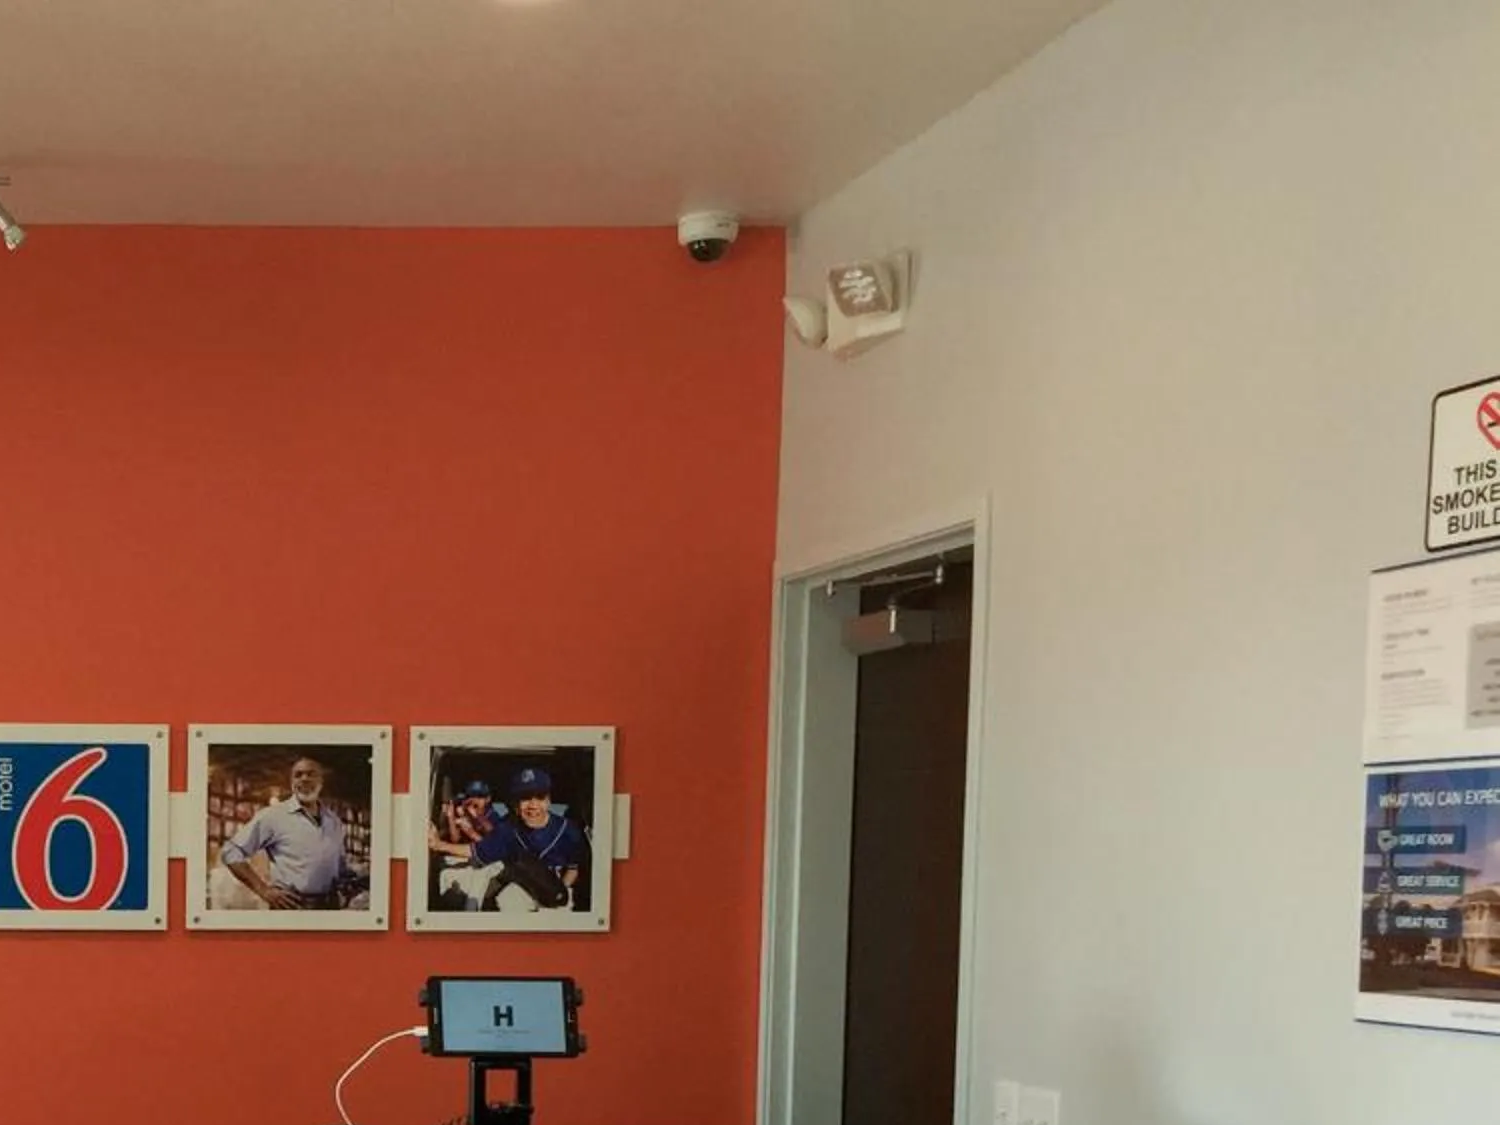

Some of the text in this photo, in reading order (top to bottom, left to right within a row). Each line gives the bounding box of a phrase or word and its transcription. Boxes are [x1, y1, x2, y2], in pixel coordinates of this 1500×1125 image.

[1454, 459, 1497, 485] THIS
[1432, 482, 1500, 515] SMOKE
[1379, 792, 1410, 808] WHAT
[1412, 791, 1436, 807] YOU
[1437, 789, 1462, 806] CAN
[11, 747, 129, 911] 6
[493, 1005, 514, 1027] H
